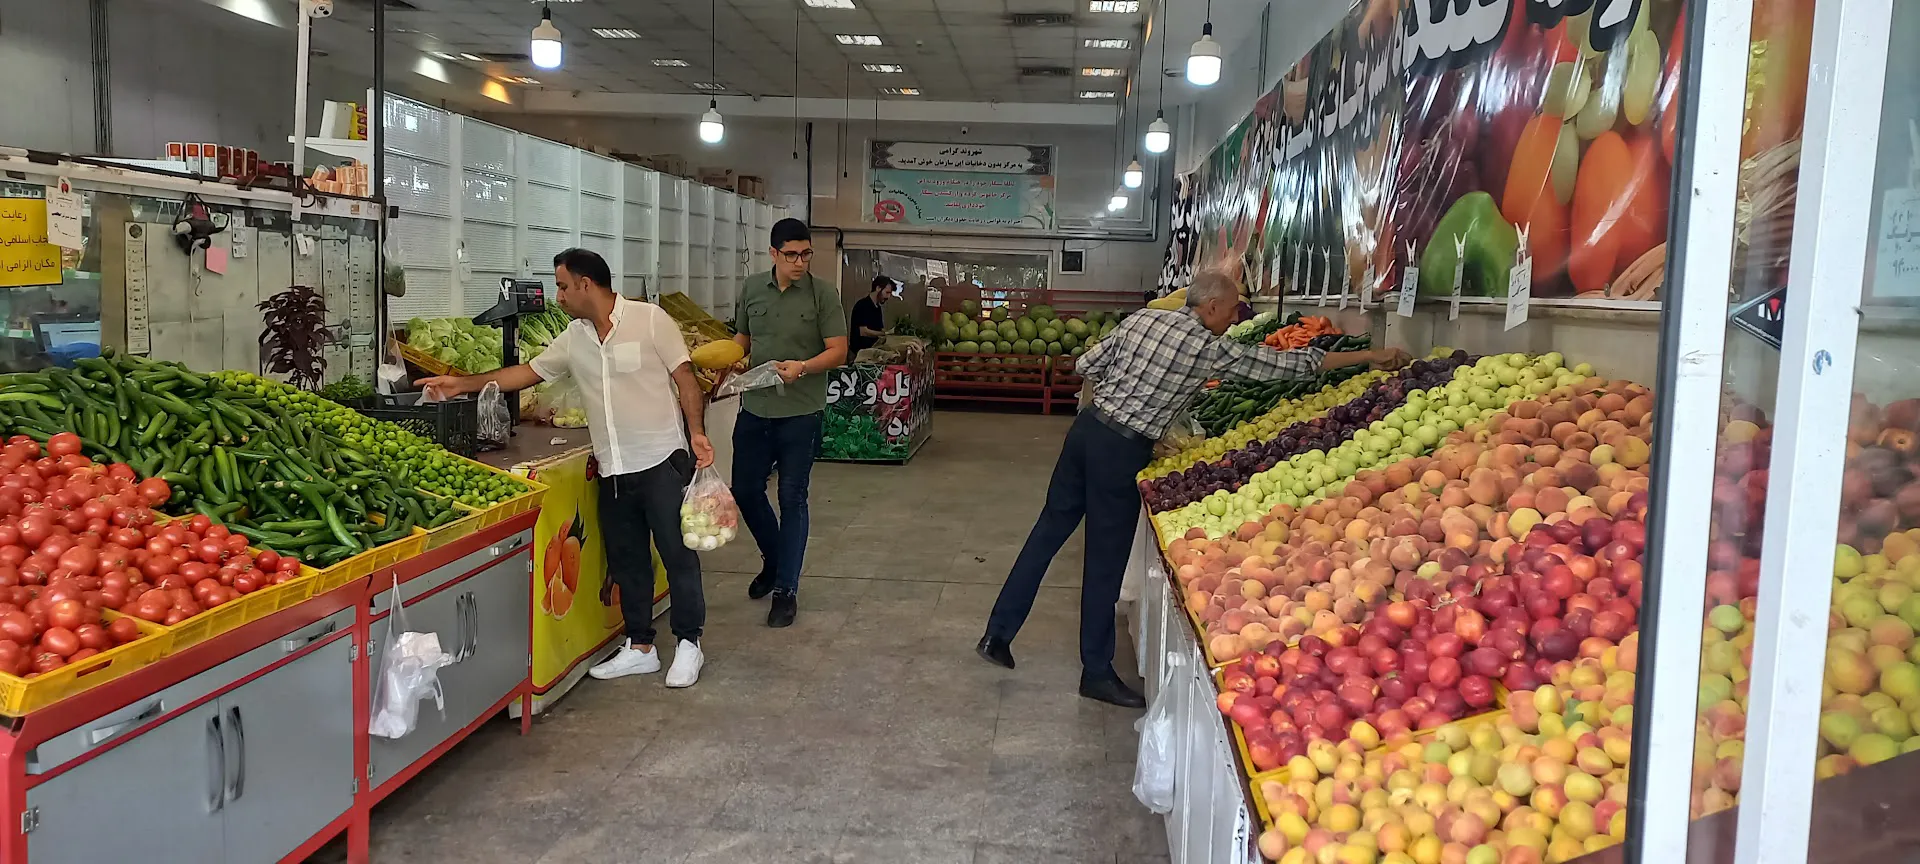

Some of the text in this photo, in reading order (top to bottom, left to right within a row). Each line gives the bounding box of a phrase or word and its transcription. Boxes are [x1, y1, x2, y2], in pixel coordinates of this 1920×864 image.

[938, 146, 983, 157] شهروند گرامی
[917, 157, 932, 166] خوش
[933, 159, 953, 167] سازمان
[954, 159, 964, 167] این
[964, 159, 987, 168] دخانیات
[987, 160, 1002, 169] بدون
[1003, 161, 1016, 169] مرکز
[1017, 162, 1023, 170] به
[1, 209, 27, 222] رعایت
[4, 234, 31, 247] اسلامی
[32, 234, 48, 247] جاب
[6, 259, 32, 272] الزامی
[34, 258, 56, 271] مکان
[827, 371, 858, 404] لای
[862, 382, 878, 405] و
[882, 371, 910, 404] گل
